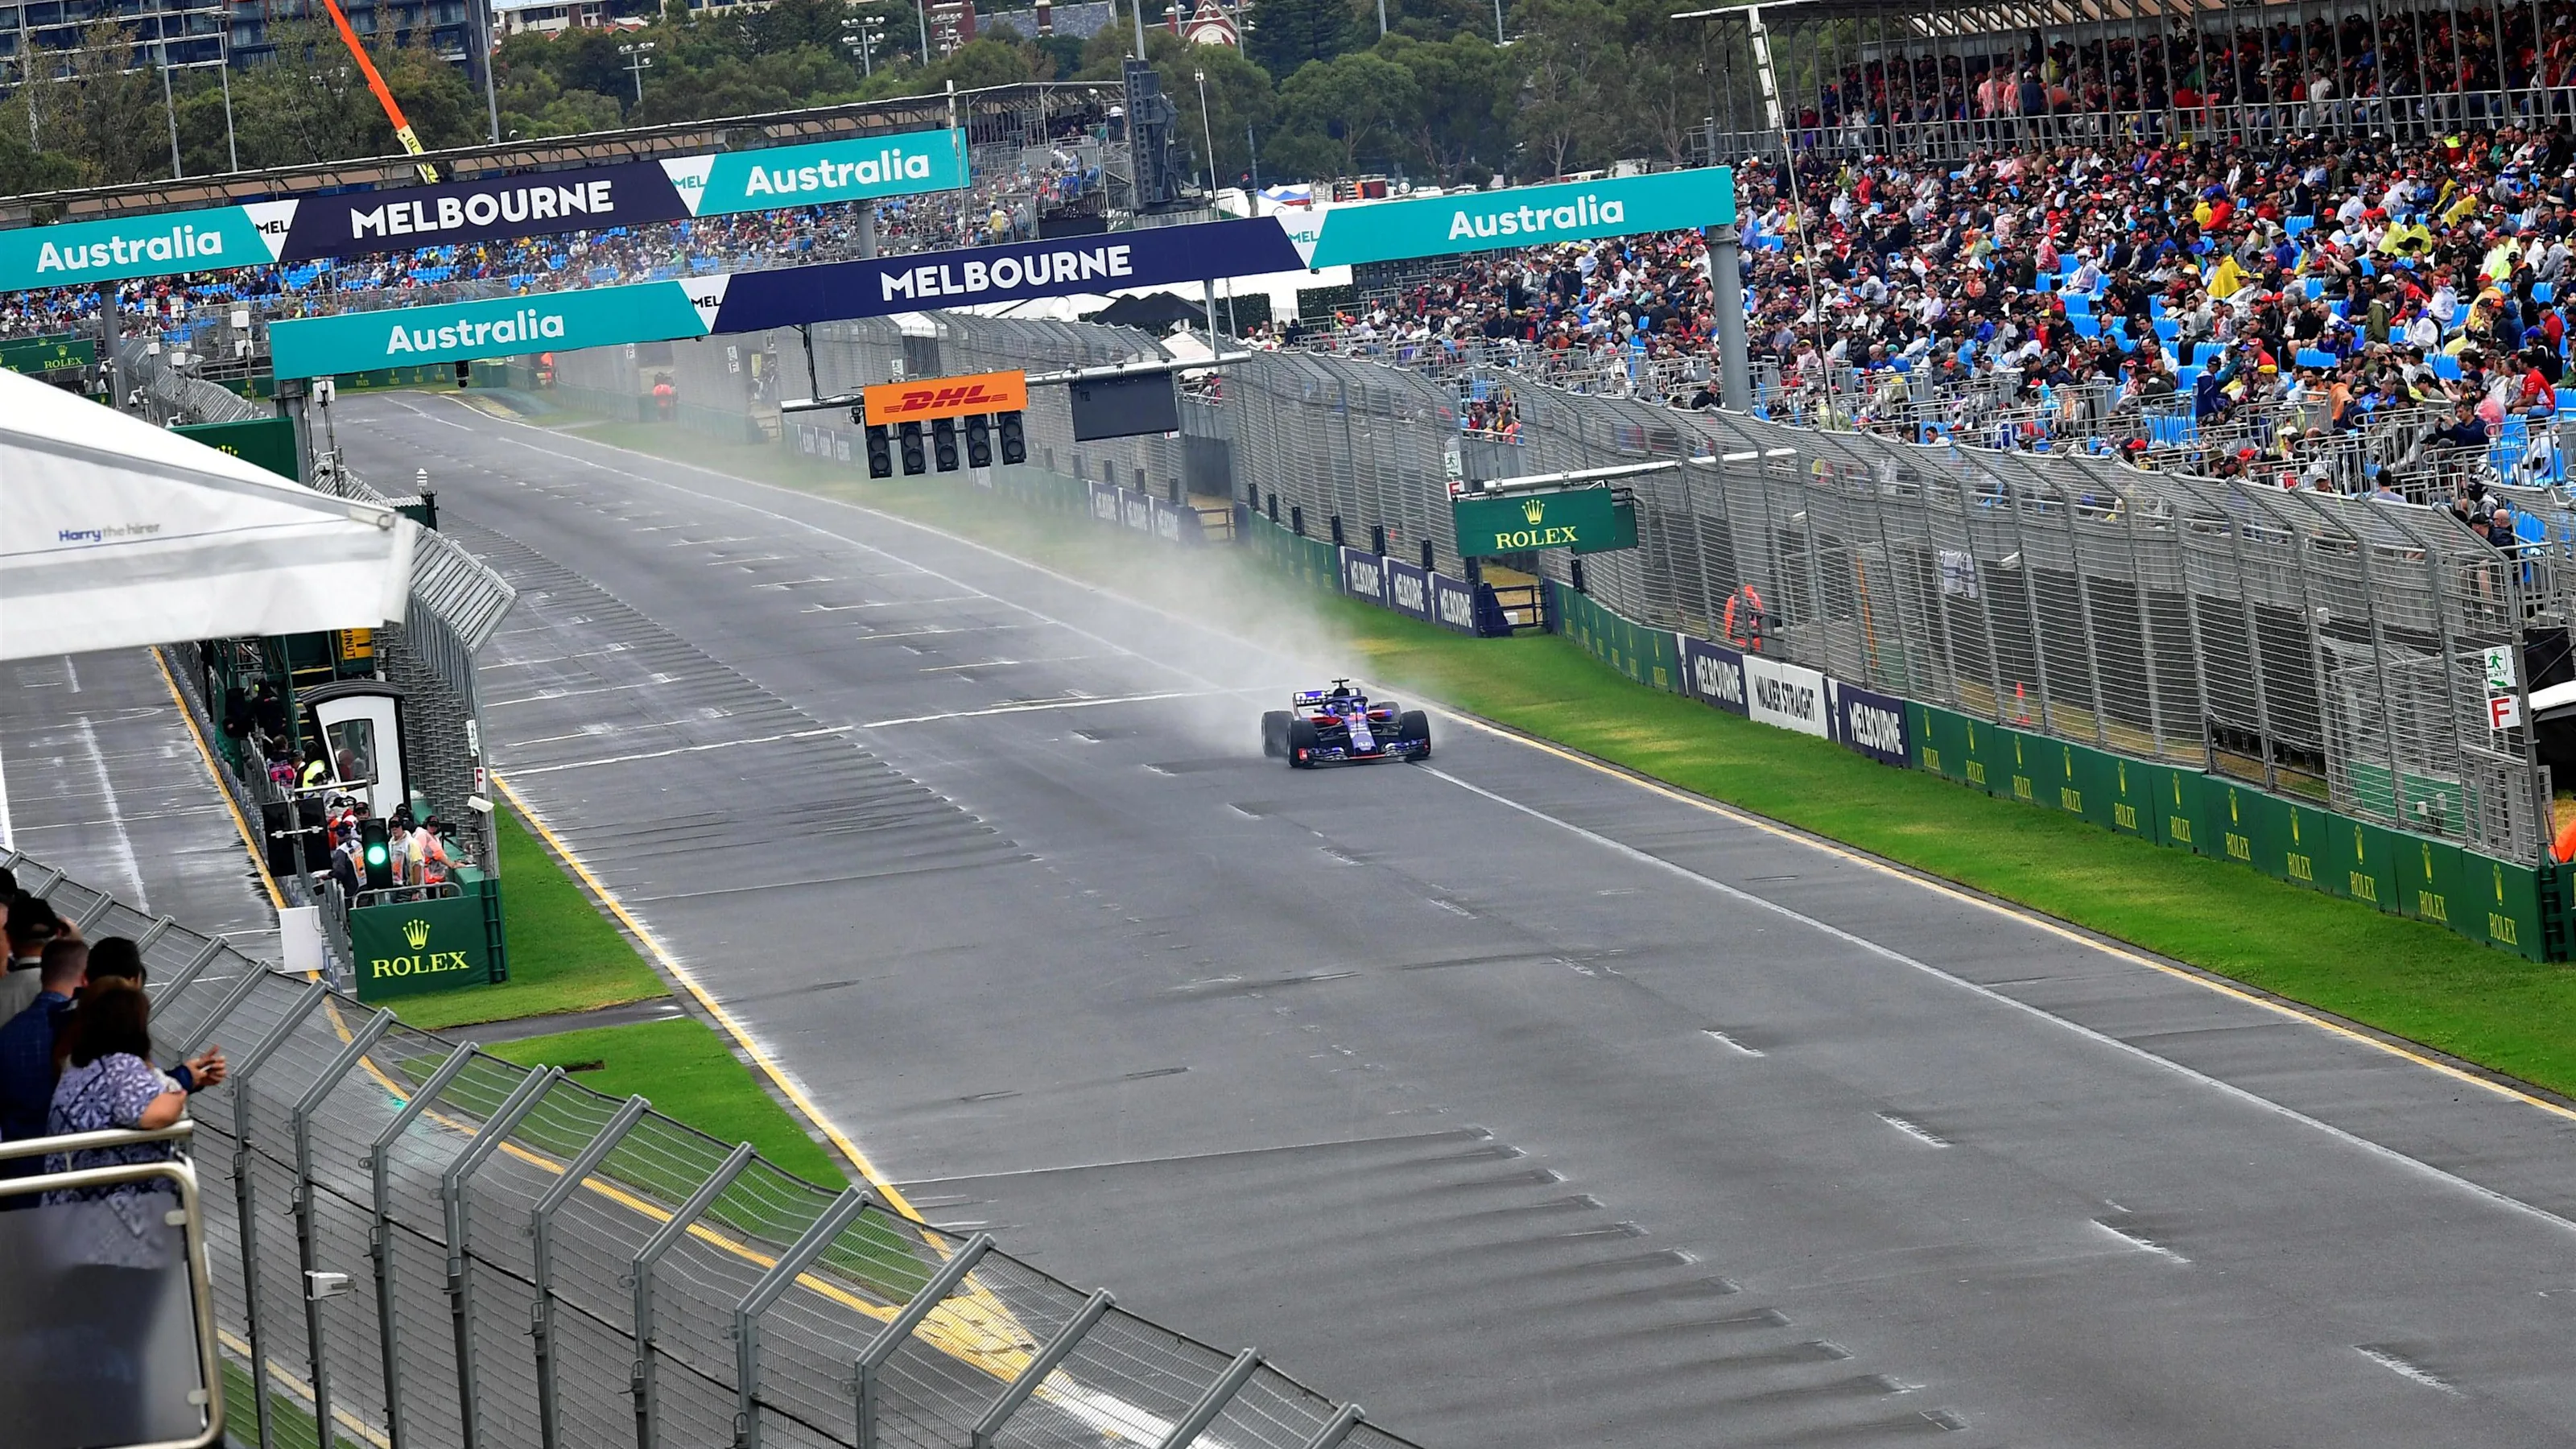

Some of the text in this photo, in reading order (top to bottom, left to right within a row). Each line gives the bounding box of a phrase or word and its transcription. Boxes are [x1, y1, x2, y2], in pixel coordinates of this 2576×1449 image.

[672, 175, 706, 189] MEL
[745, 148, 930, 196] Australia
[350, 180, 614, 239] MELBOURNE
[1448, 194, 1624, 241] Australia
[255, 220, 291, 235] MEL
[1287, 230, 1319, 244] MEL
[36, 225, 223, 274] Australia
[880, 244, 1133, 302] MELBOURNE
[691, 295, 722, 309] MEL
[386, 308, 564, 355] Australia
[44, 357, 83, 369] ROLEX
[900, 384, 991, 412] DHL
[59, 529, 101, 542] Harry
[1495, 526, 1579, 550] ROLEX
[1350, 560, 1381, 597] MELBOURNE
[1393, 572, 1424, 612] MELBOURNE
[1439, 587, 1472, 628] MELBOURNE
[1694, 654, 1744, 705] MELBOURNE
[1754, 674, 1815, 722] WALKER STRAIGHT
[1847, 699, 1904, 756] MELBOURNE
[2491, 698, 2510, 728] F
[476, 768, 483, 791] F
[1966, 760, 1986, 785] ROLEX
[2013, 774, 2033, 800] ROLEX
[2061, 786, 2083, 814] ROLEX
[2113, 802, 2137, 829] ROLEX
[2170, 815, 2192, 843] ROLEX
[2225, 832, 2251, 861] ROLEX
[2287, 852, 2313, 881] ROLEX
[2350, 870, 2376, 902] ROLEX
[2418, 890, 2447, 922] ROLEX
[2488, 911, 2517, 946] ROLEX
[370, 951, 470, 979] ROLEX
